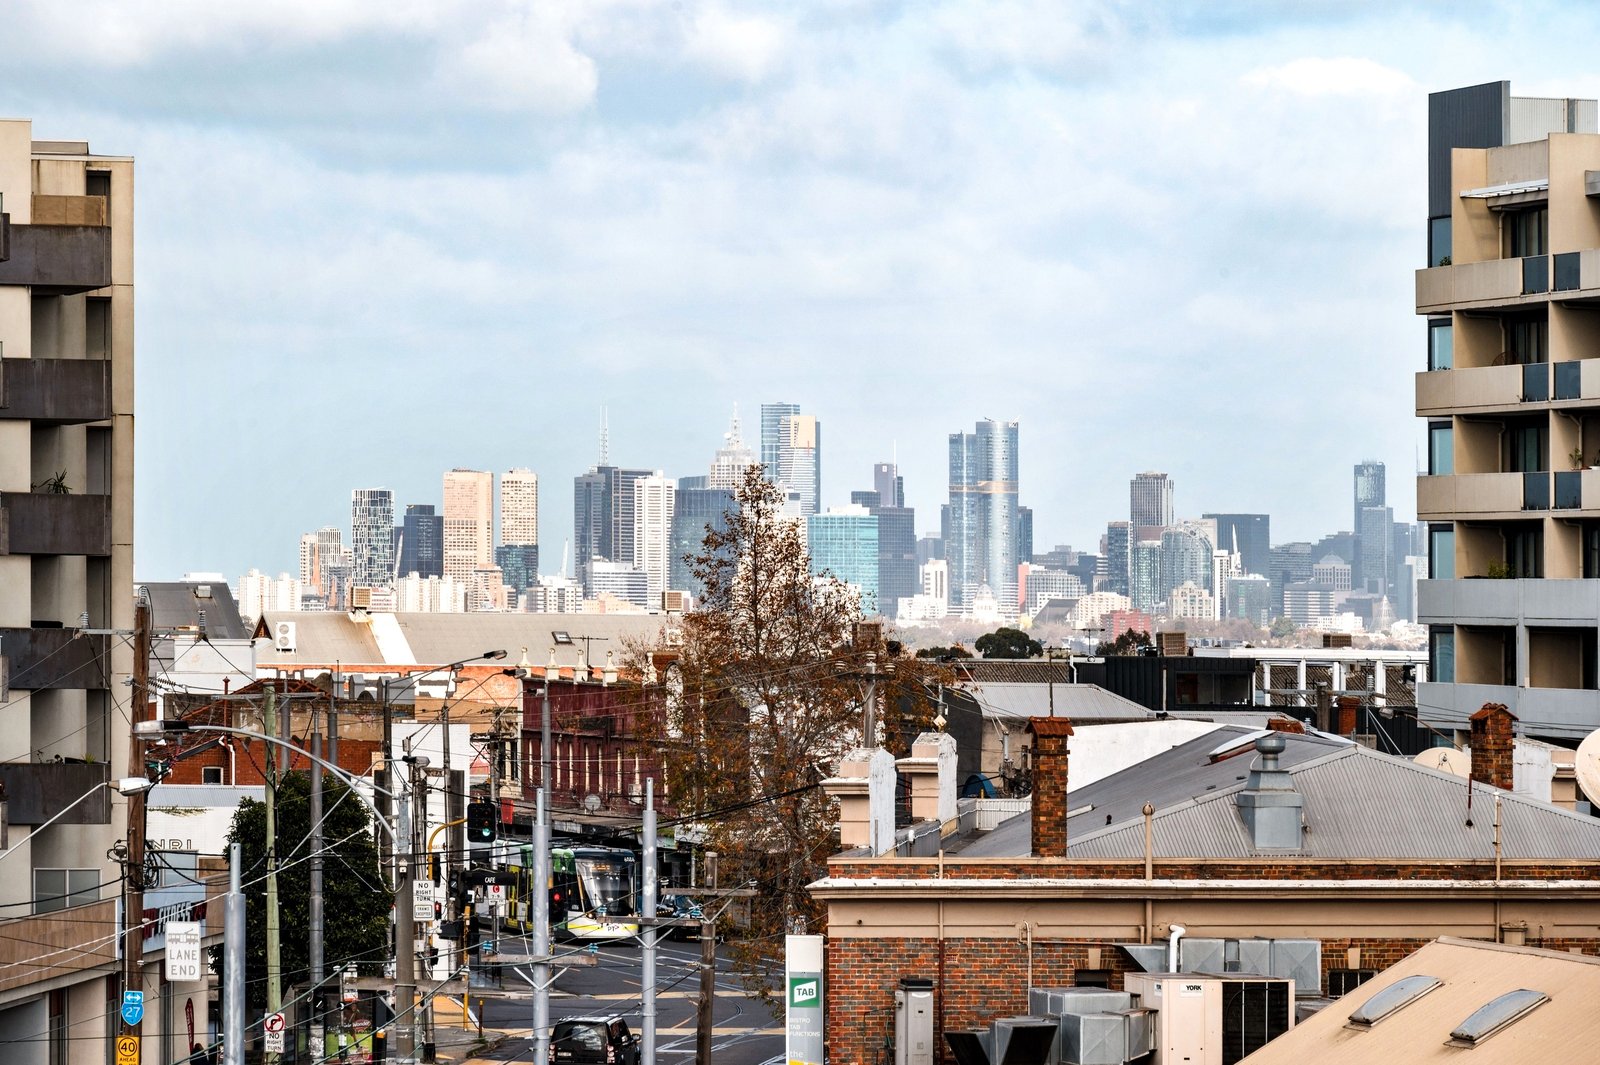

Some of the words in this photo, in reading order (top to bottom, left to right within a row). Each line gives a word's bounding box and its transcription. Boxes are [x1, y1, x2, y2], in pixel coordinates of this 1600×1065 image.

[169, 949, 198, 961] LANE
[171, 964, 197, 976] END
[796, 988, 814, 997] TAB
[125, 1006, 141, 1018] 27
[121, 1042, 135, 1053] 40
[790, 1049, 804, 1058] the
